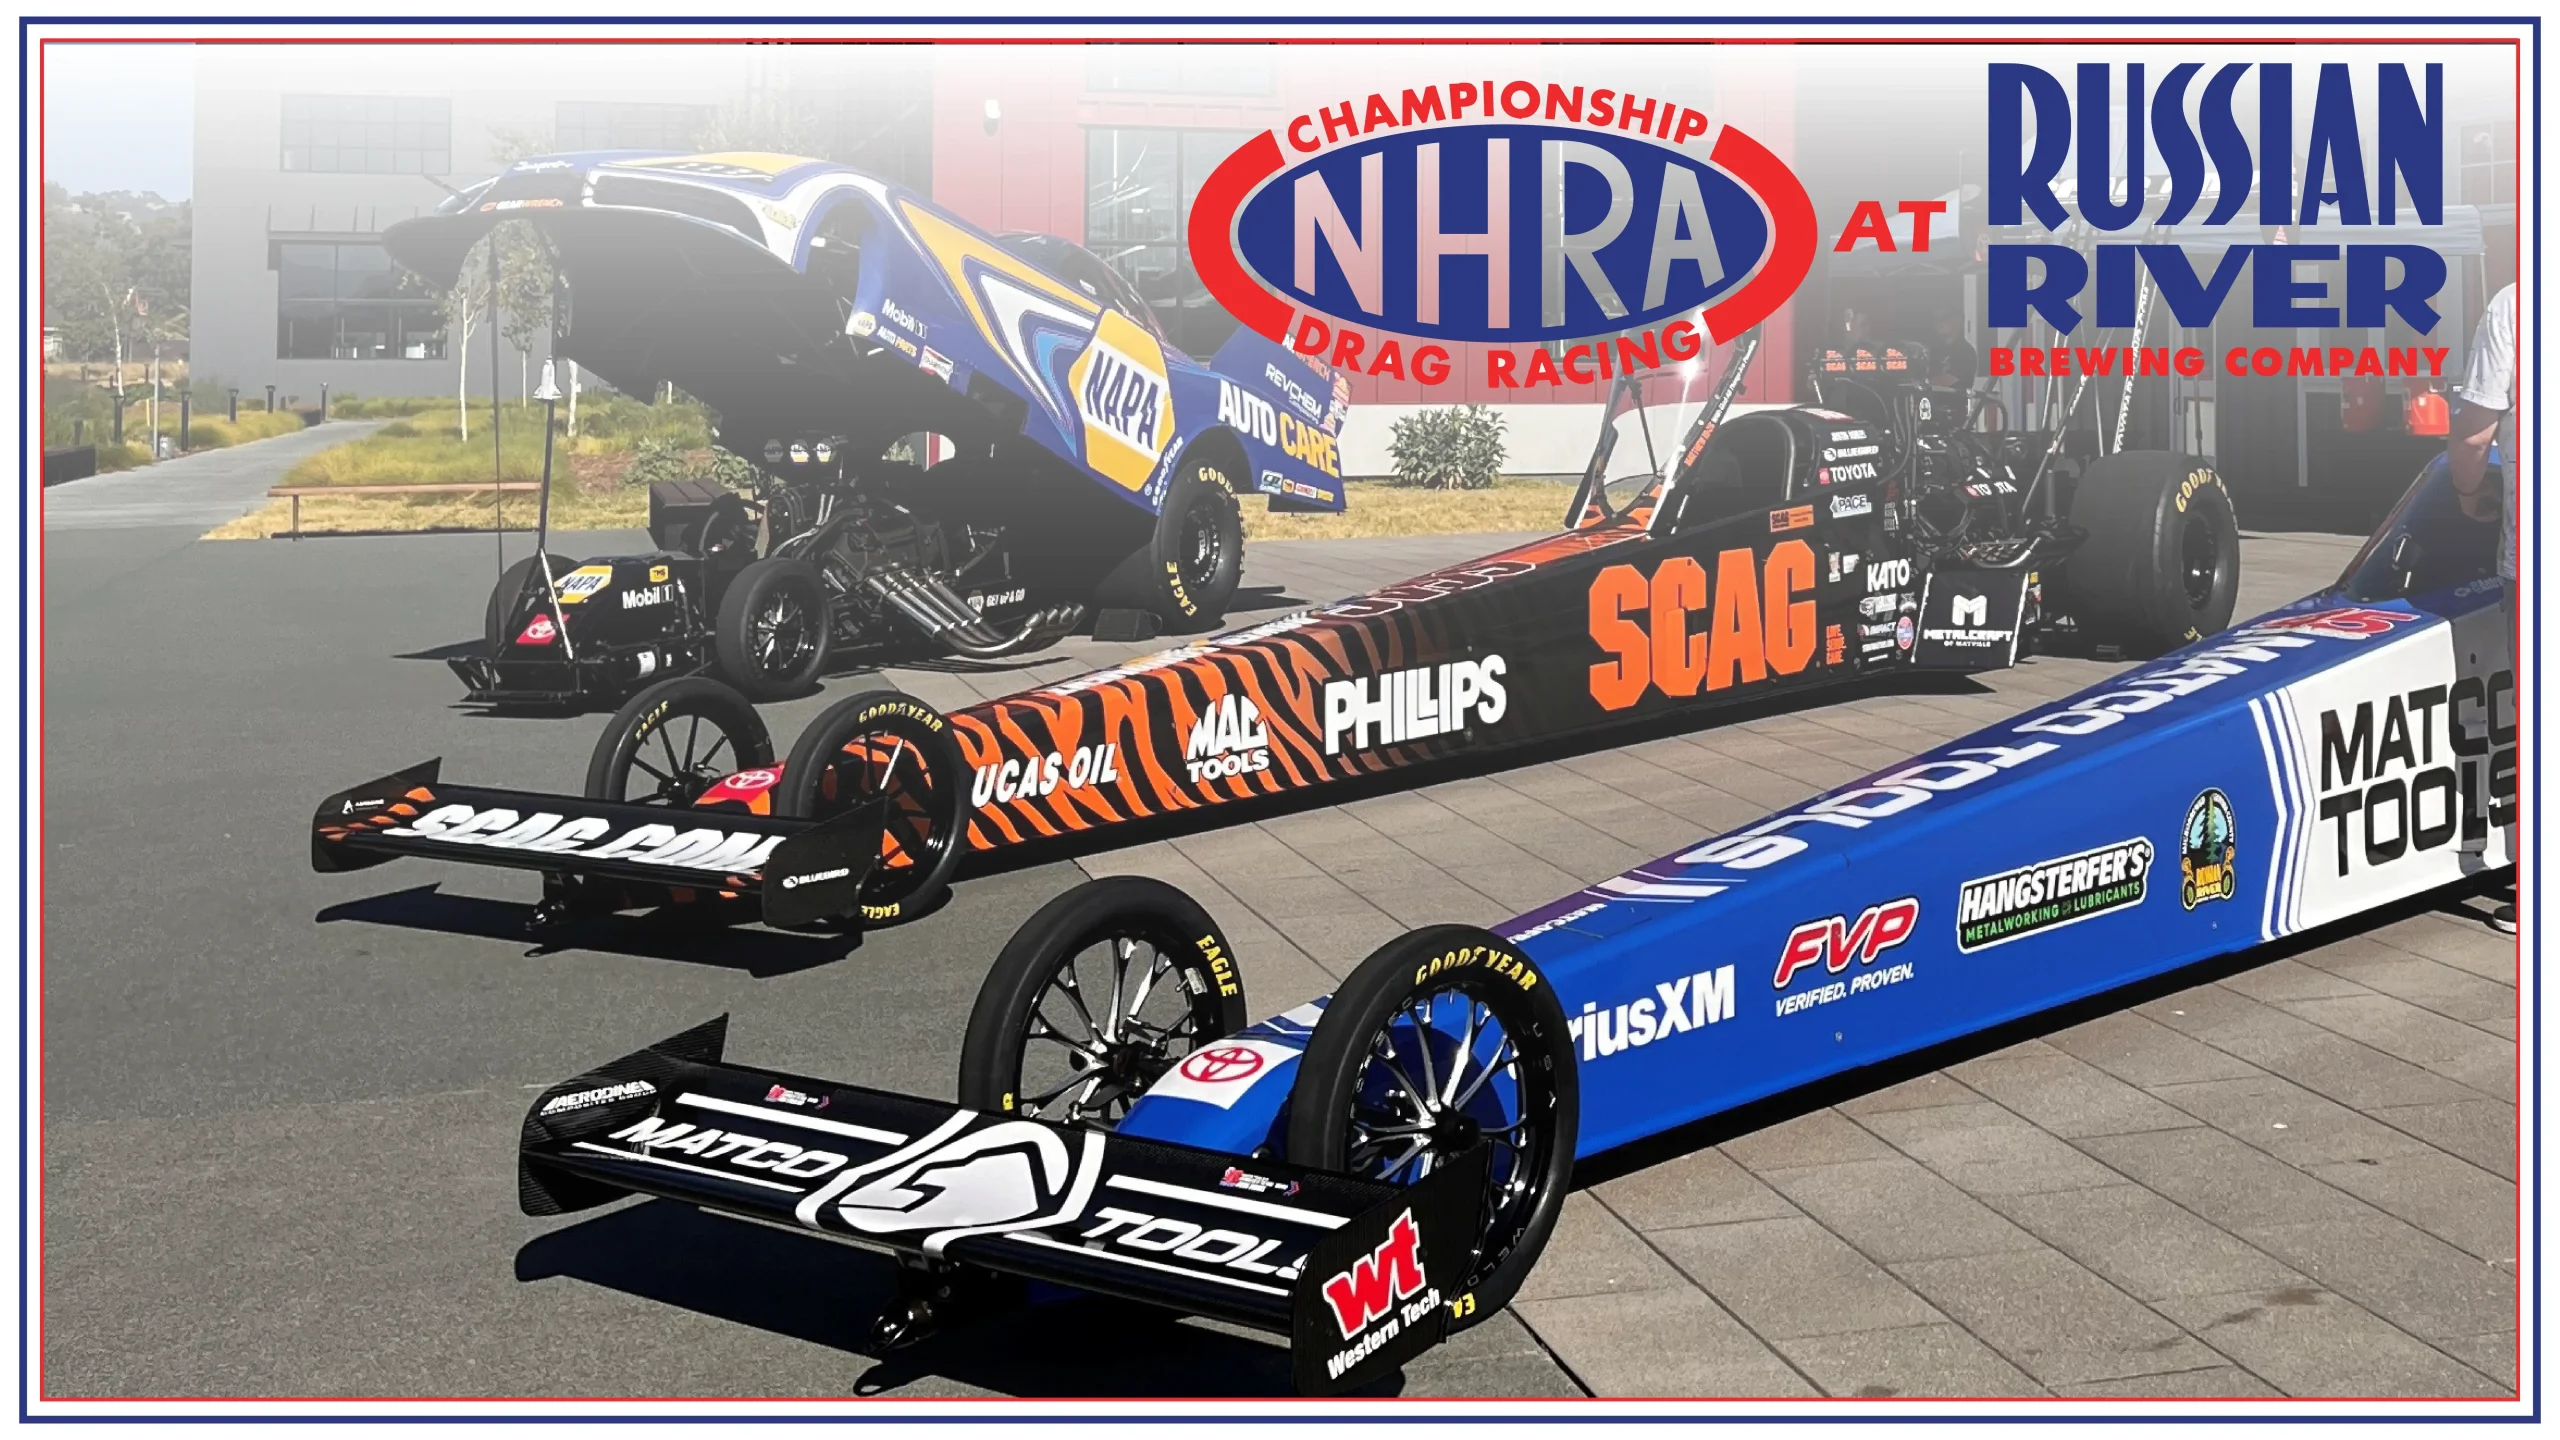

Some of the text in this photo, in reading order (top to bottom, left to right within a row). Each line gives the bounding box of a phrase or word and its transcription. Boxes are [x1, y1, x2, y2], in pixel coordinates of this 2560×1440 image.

[881, 298, 915, 332] Mobil
[1085, 350, 1164, 454] NAPA
[1218, 378, 1277, 446] AUTO
[1280, 411, 1340, 479] CARE
[1830, 462, 1878, 482] TOYOTA
[1838, 494, 1868, 512] PACE
[560, 575, 604, 593] NAPA
[622, 586, 660, 609] Mobil
[1166, 561, 1197, 617] EAGLE
[1867, 558, 1911, 593] KATO
[1589, 539, 1817, 712] SCAG
[1923, 628, 2014, 642] METALCRAFT
[1324, 653, 1509, 756] PHILLIPS
[2011, 628, 2317, 735] MATCO
[859, 702, 943, 732] GOODYEAR
[1187, 694, 1269, 760] MAC
[2319, 669, 2515, 792] MATCO
[971, 743, 1120, 808] UCAS OIL
[1187, 748, 1270, 783] TOOLS
[1673, 739, 2060, 870] TOOLS
[2319, 746, 2515, 878] TOOLS
[799, 867, 849, 884] BLUEBIRD
[1961, 842, 2146, 924] HANGSTERFER'S
[861, 903, 900, 919] EAGLE
[1966, 881, 2140, 943] METALWORKING LUBRICANTS
[1195, 934, 1239, 997] EAGLE
[1415, 946, 1540, 993] GOODYEAR
[1773, 897, 1920, 990] FVP
[1567, 963, 1735, 1062] riusXM
[1775, 961, 1914, 1018] VERIFIED. PROVEN.
[542, 1080, 657, 1112] AERODINE
[608, 1116, 848, 1178] MATCO
[1323, 1207, 1428, 1340] wt
[1327, 1319, 1401, 1380] Western
[1400, 1286, 1440, 1330] Tech
